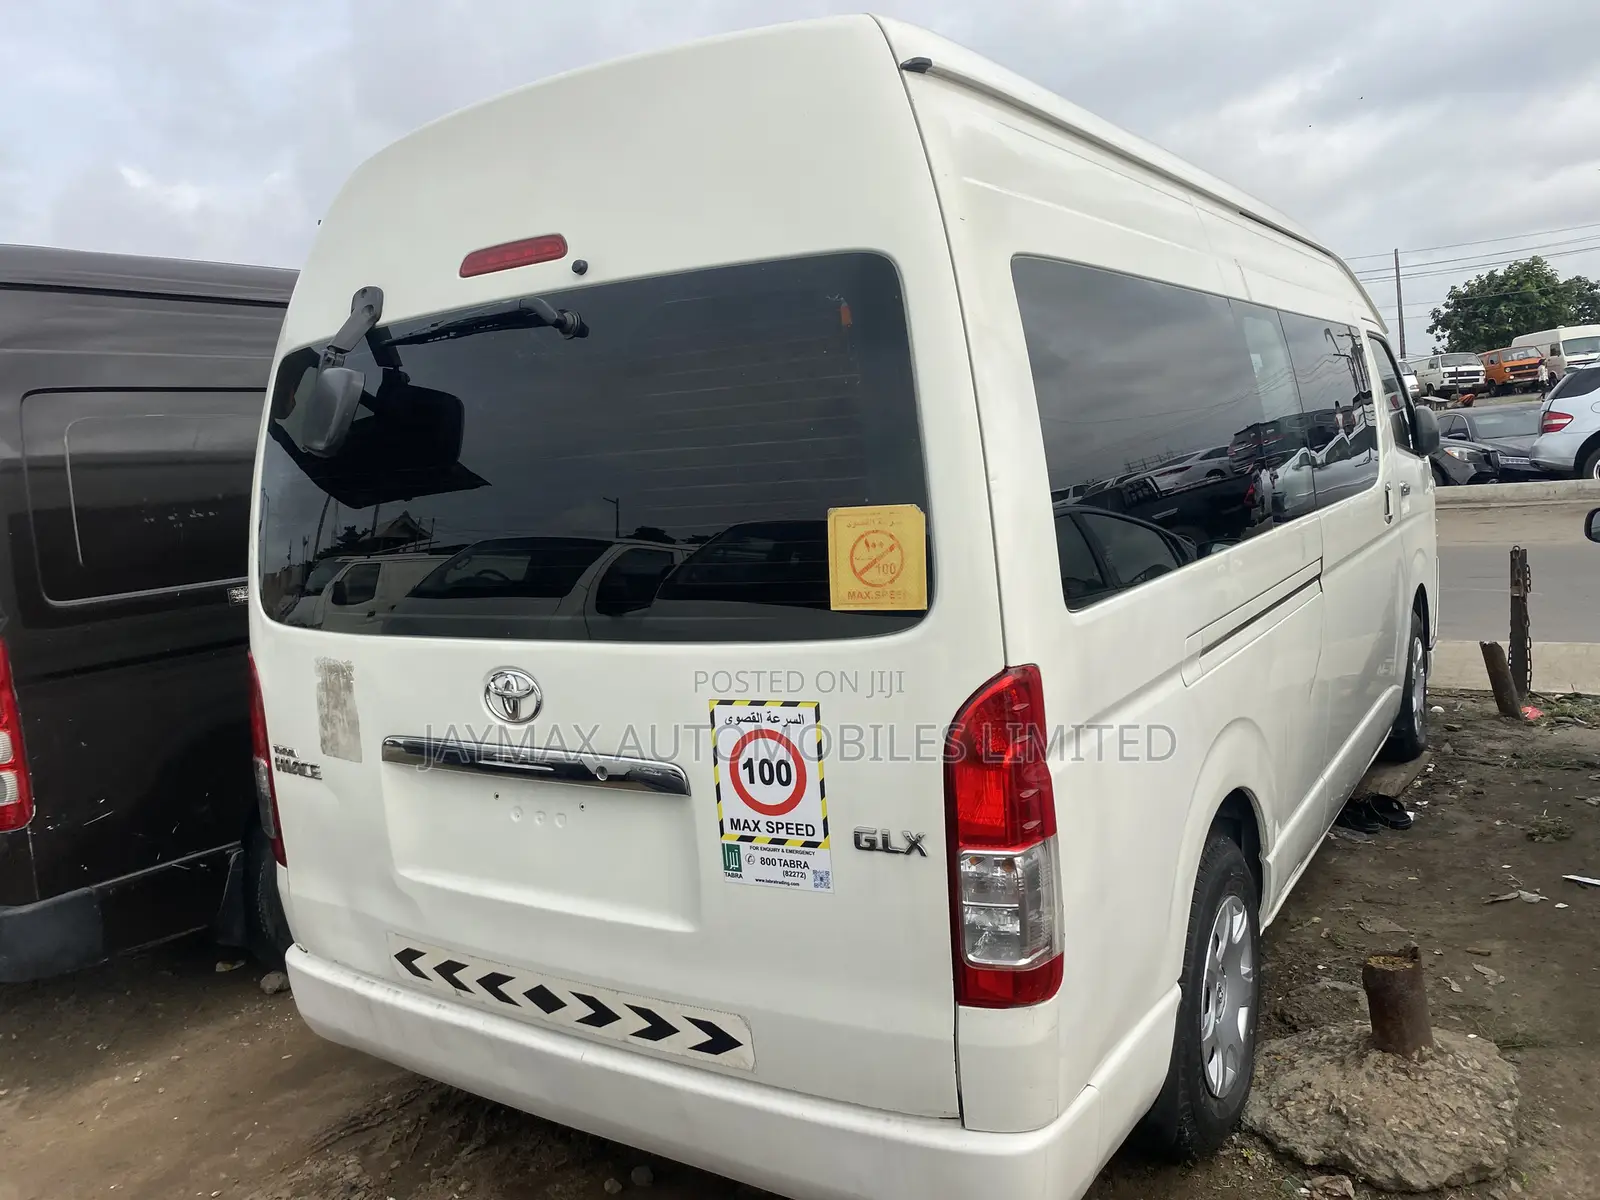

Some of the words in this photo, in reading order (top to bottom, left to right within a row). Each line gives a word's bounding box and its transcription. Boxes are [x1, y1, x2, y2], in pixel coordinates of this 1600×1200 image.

[875, 562, 896, 575] 100
[724, 711, 763, 725] القصوى
[766, 711, 805, 727] السرعة
[742, 757, 792, 787] 100
[730, 817, 762, 833] MAX
[765, 820, 816, 837] SPEED
[853, 825, 929, 857] GLX
[786, 848, 815, 856] EMERGENCY
[760, 856, 777, 867] 800
[777, 858, 810, 870] TABRA
[724, 871, 743, 879] TABRA
[782, 870, 807, 880] (82272)
